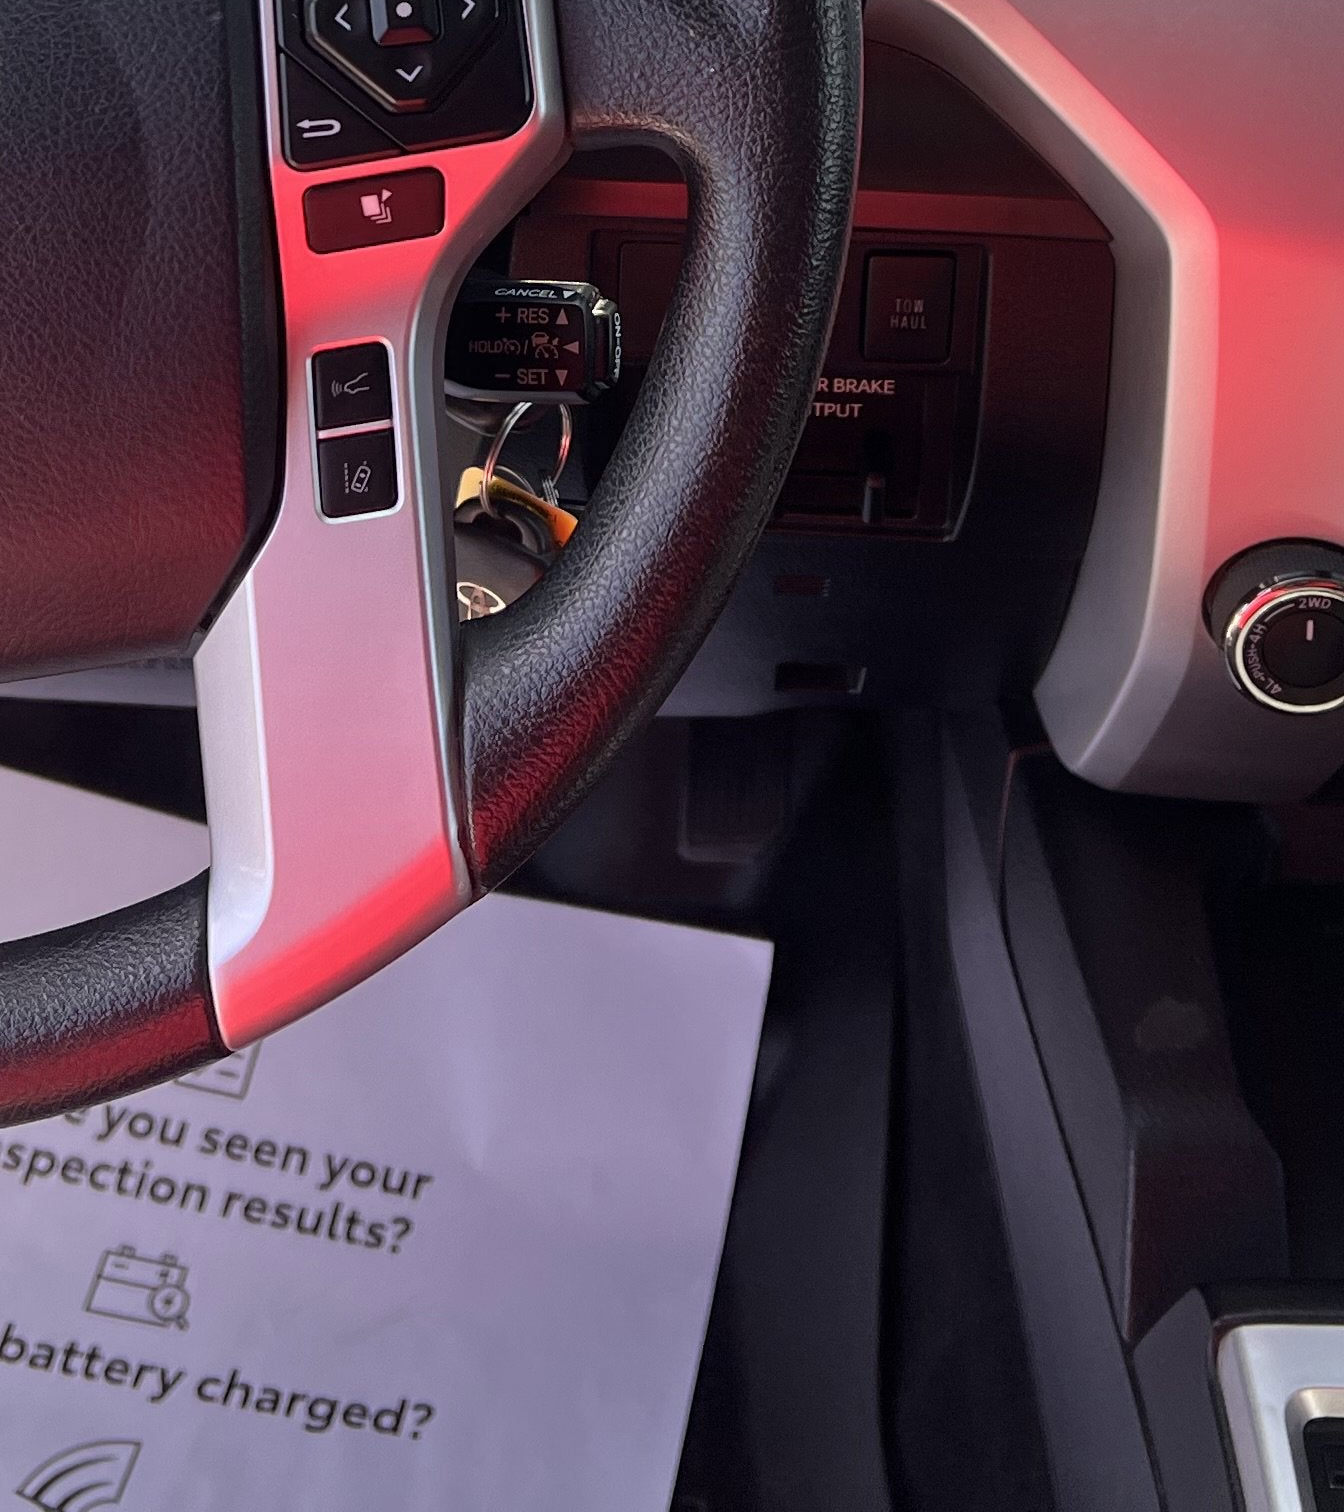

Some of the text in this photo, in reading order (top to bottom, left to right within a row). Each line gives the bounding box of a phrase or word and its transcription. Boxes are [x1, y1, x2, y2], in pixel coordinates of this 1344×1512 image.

[494, 287, 559, 299] CANCEL
[895, 298, 924, 313] TOW
[516, 307, 549, 324] RES
[890, 315, 927, 330] HAUL
[468, 339, 503, 354] HOLD
[516, 368, 549, 385] SET
[833, 378, 895, 395] BRAKE
[1298, 597, 1332, 610] 2WD
[97, 1102, 434, 1202] you seen your
[220, 1192, 414, 1255] results?
[195, 1367, 436, 1442] charged?
